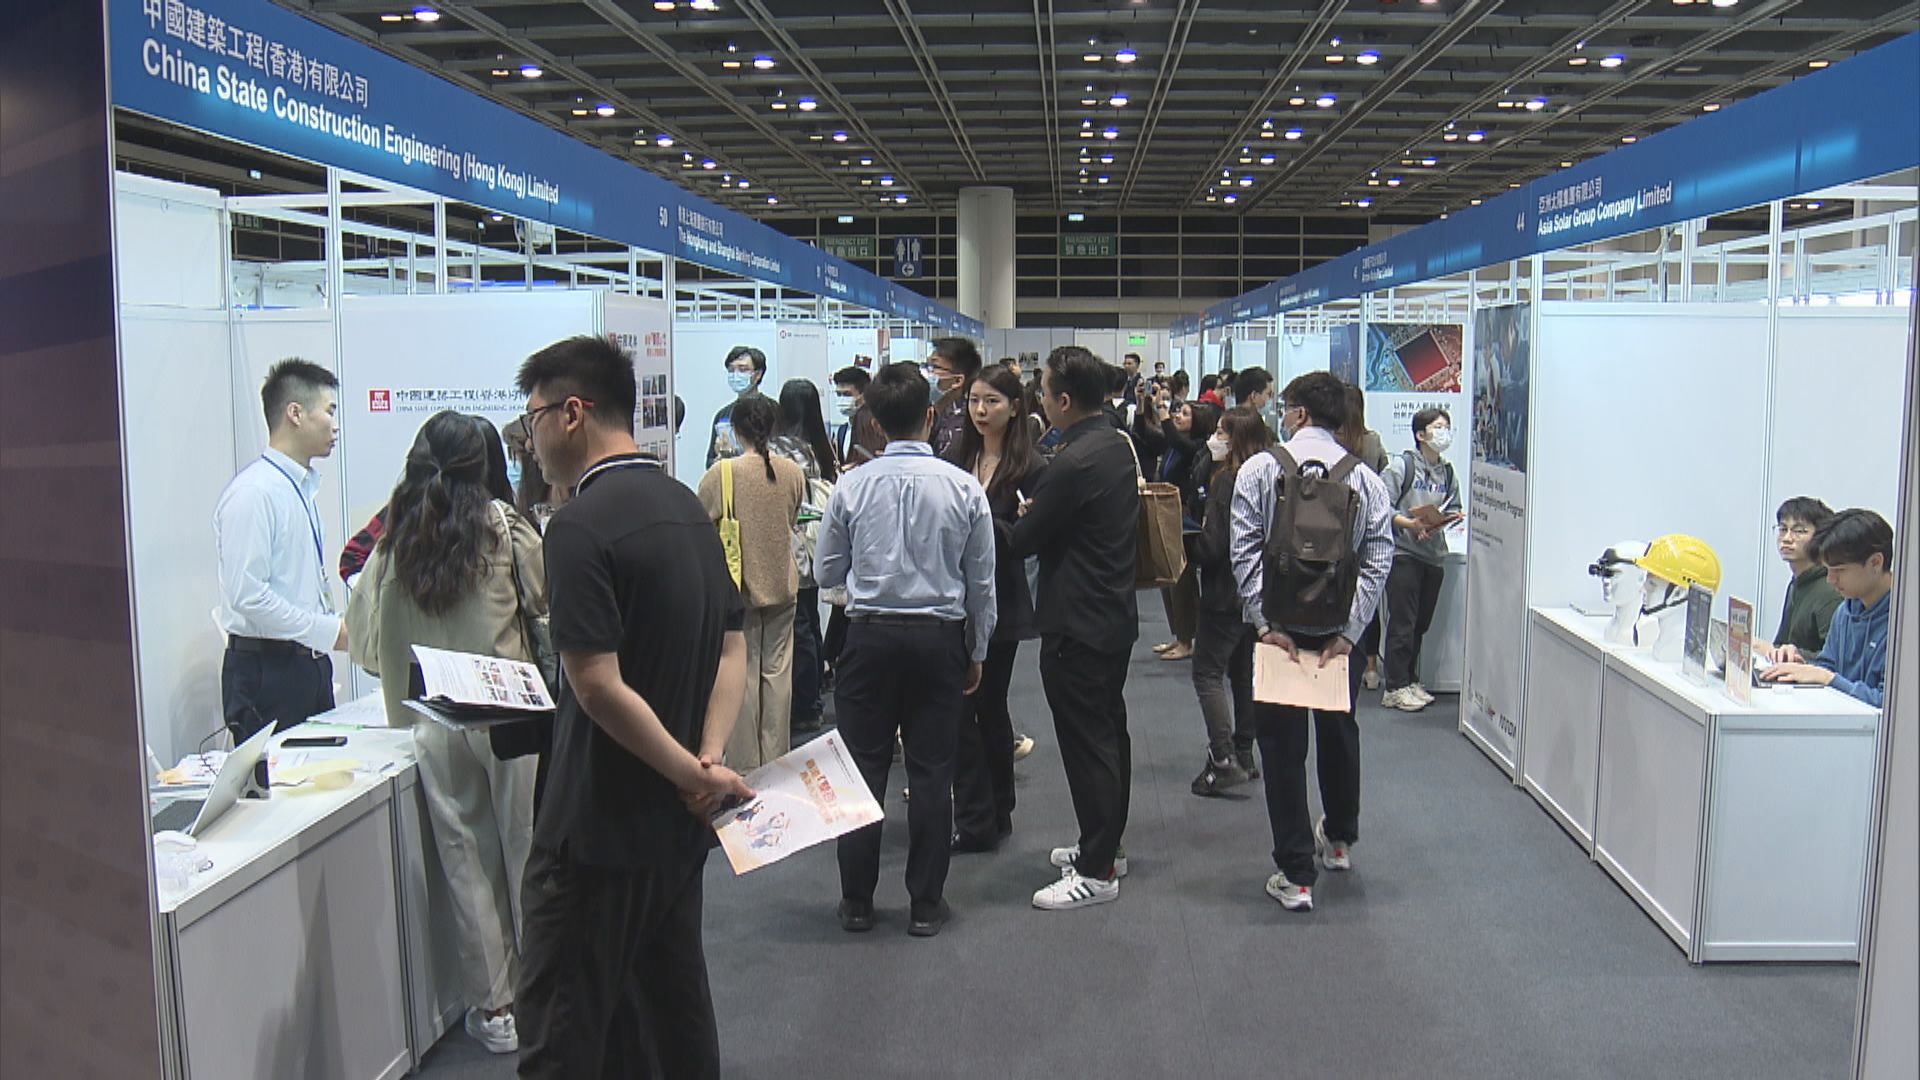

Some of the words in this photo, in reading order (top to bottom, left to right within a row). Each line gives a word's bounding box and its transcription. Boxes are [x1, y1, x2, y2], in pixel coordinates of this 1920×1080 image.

[144, 0, 368, 109] 中國建築工程(香港)有限公司
[143, 38, 210, 94] China
[217, 65, 268, 112] State
[273, 86, 380, 148] Construction
[384, 124, 460, 179] Engineering
[463, 152, 495, 190] (Hong
[498, 165, 526, 200] Kong)
[528, 174, 559, 204] Limited
[659, 206, 669, 227] 50
[1516, 212, 1525, 233] 44
[1538, 218, 1553, 236] Asia
[1554, 212, 1572, 231] Solar
[1573, 207, 1595, 227] Group
[1597, 196, 1636, 221] Company
[1637, 181, 1672, 210] Limited
